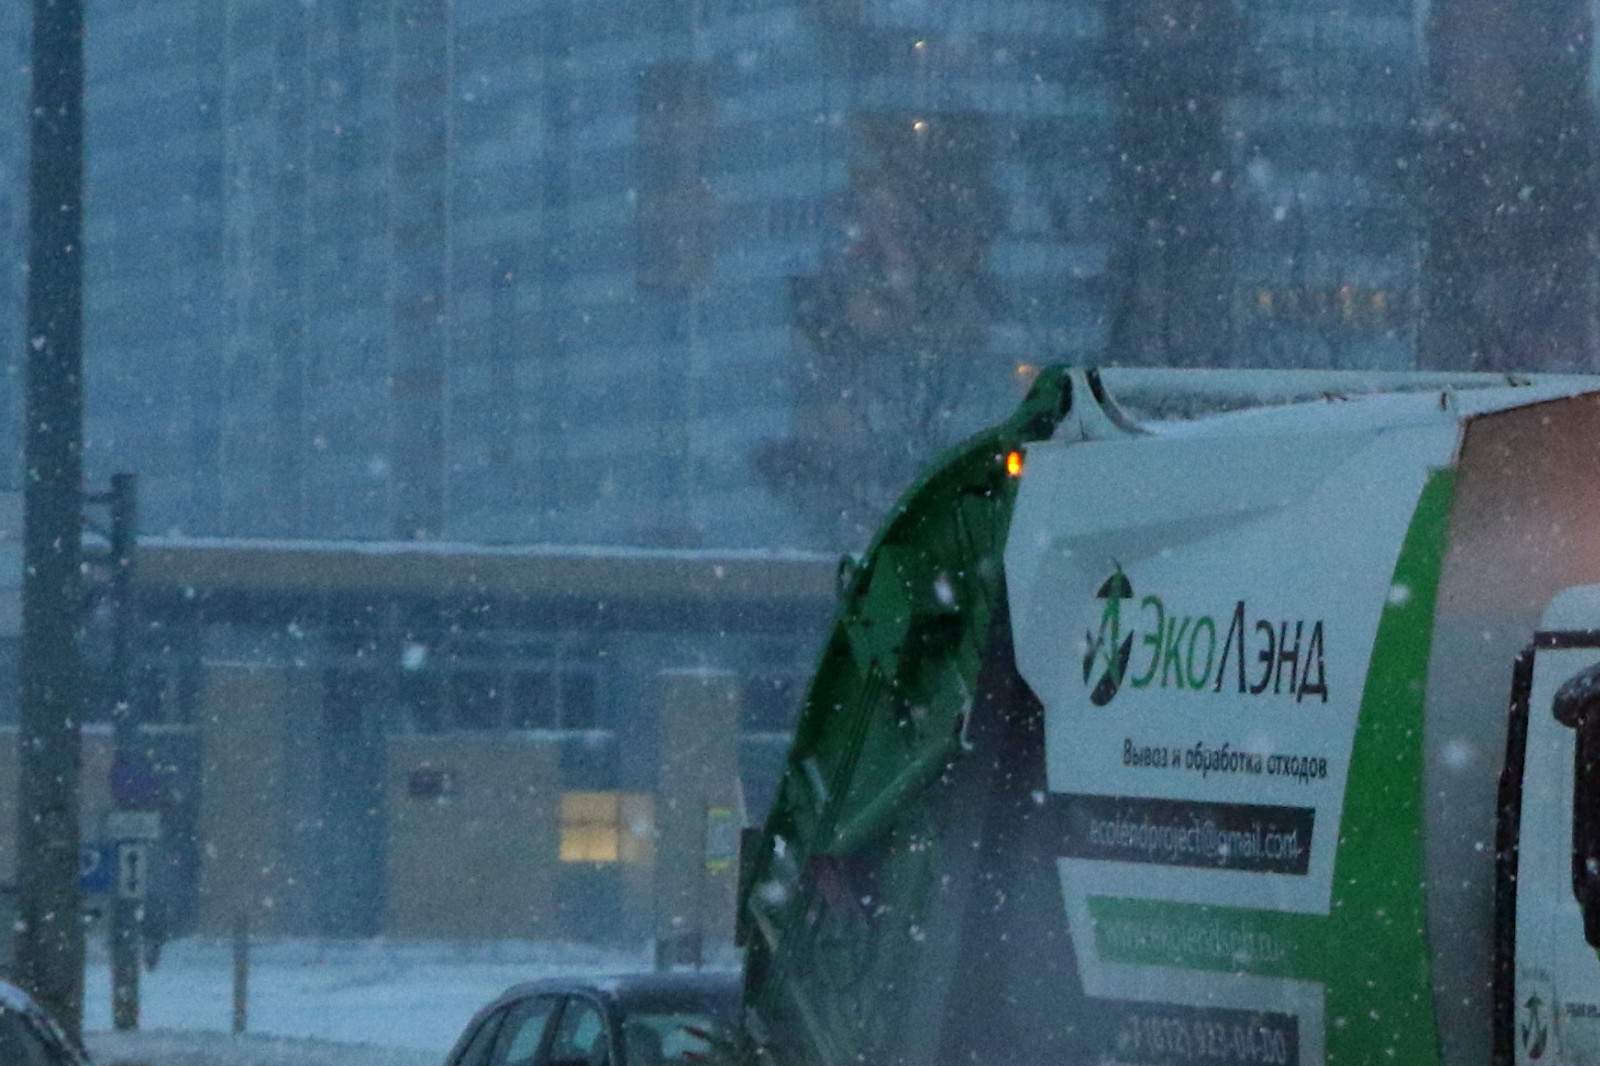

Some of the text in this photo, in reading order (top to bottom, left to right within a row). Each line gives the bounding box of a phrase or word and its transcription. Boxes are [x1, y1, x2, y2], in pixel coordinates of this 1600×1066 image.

[1122, 737, 1328, 783] Вывоз и обработка отходов
